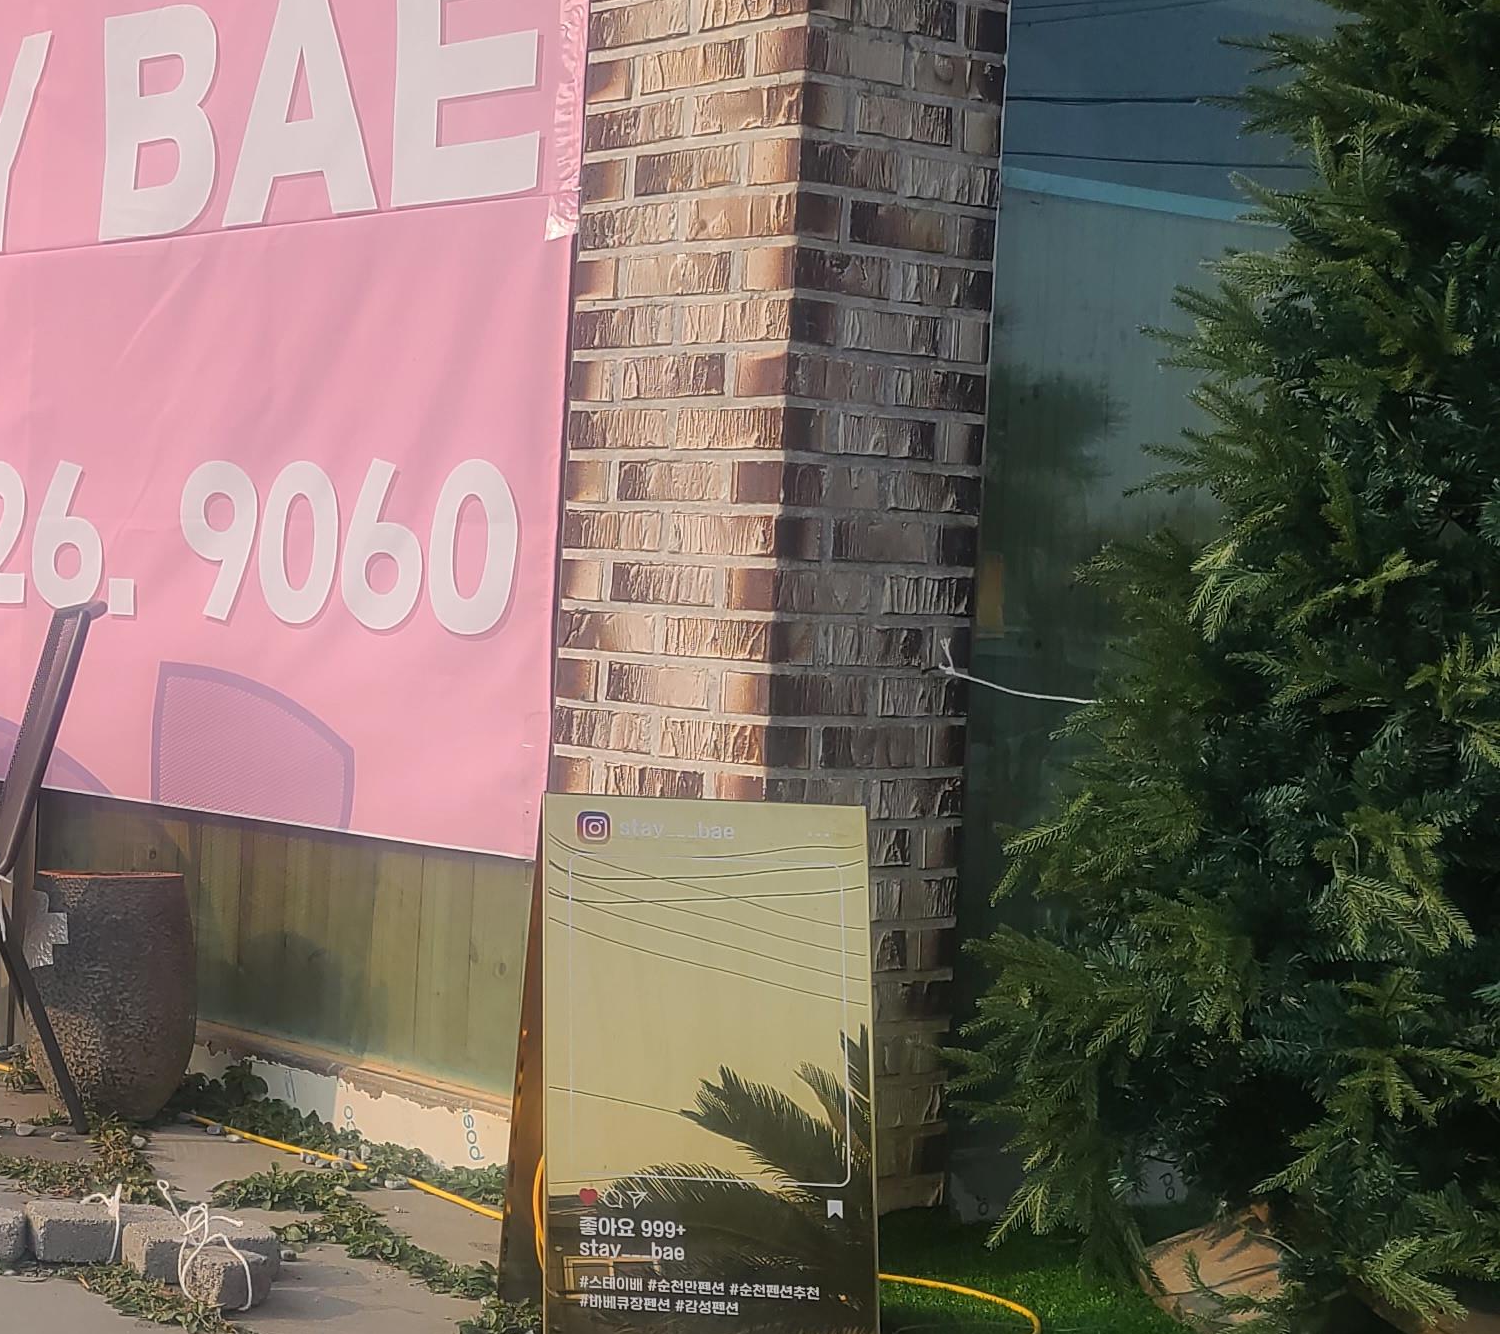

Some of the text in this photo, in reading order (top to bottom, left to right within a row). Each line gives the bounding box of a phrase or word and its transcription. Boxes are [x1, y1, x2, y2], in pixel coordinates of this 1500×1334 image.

[179, 458, 520, 637] 9060
[579, 1216, 687, 1238] 좋아요 999+
[579, 1275, 820, 1301] #스테이배 #순천만펜션 #순천펜션추천
[579, 1293, 739, 1316] #바베큐장펜션 #감성펜션
